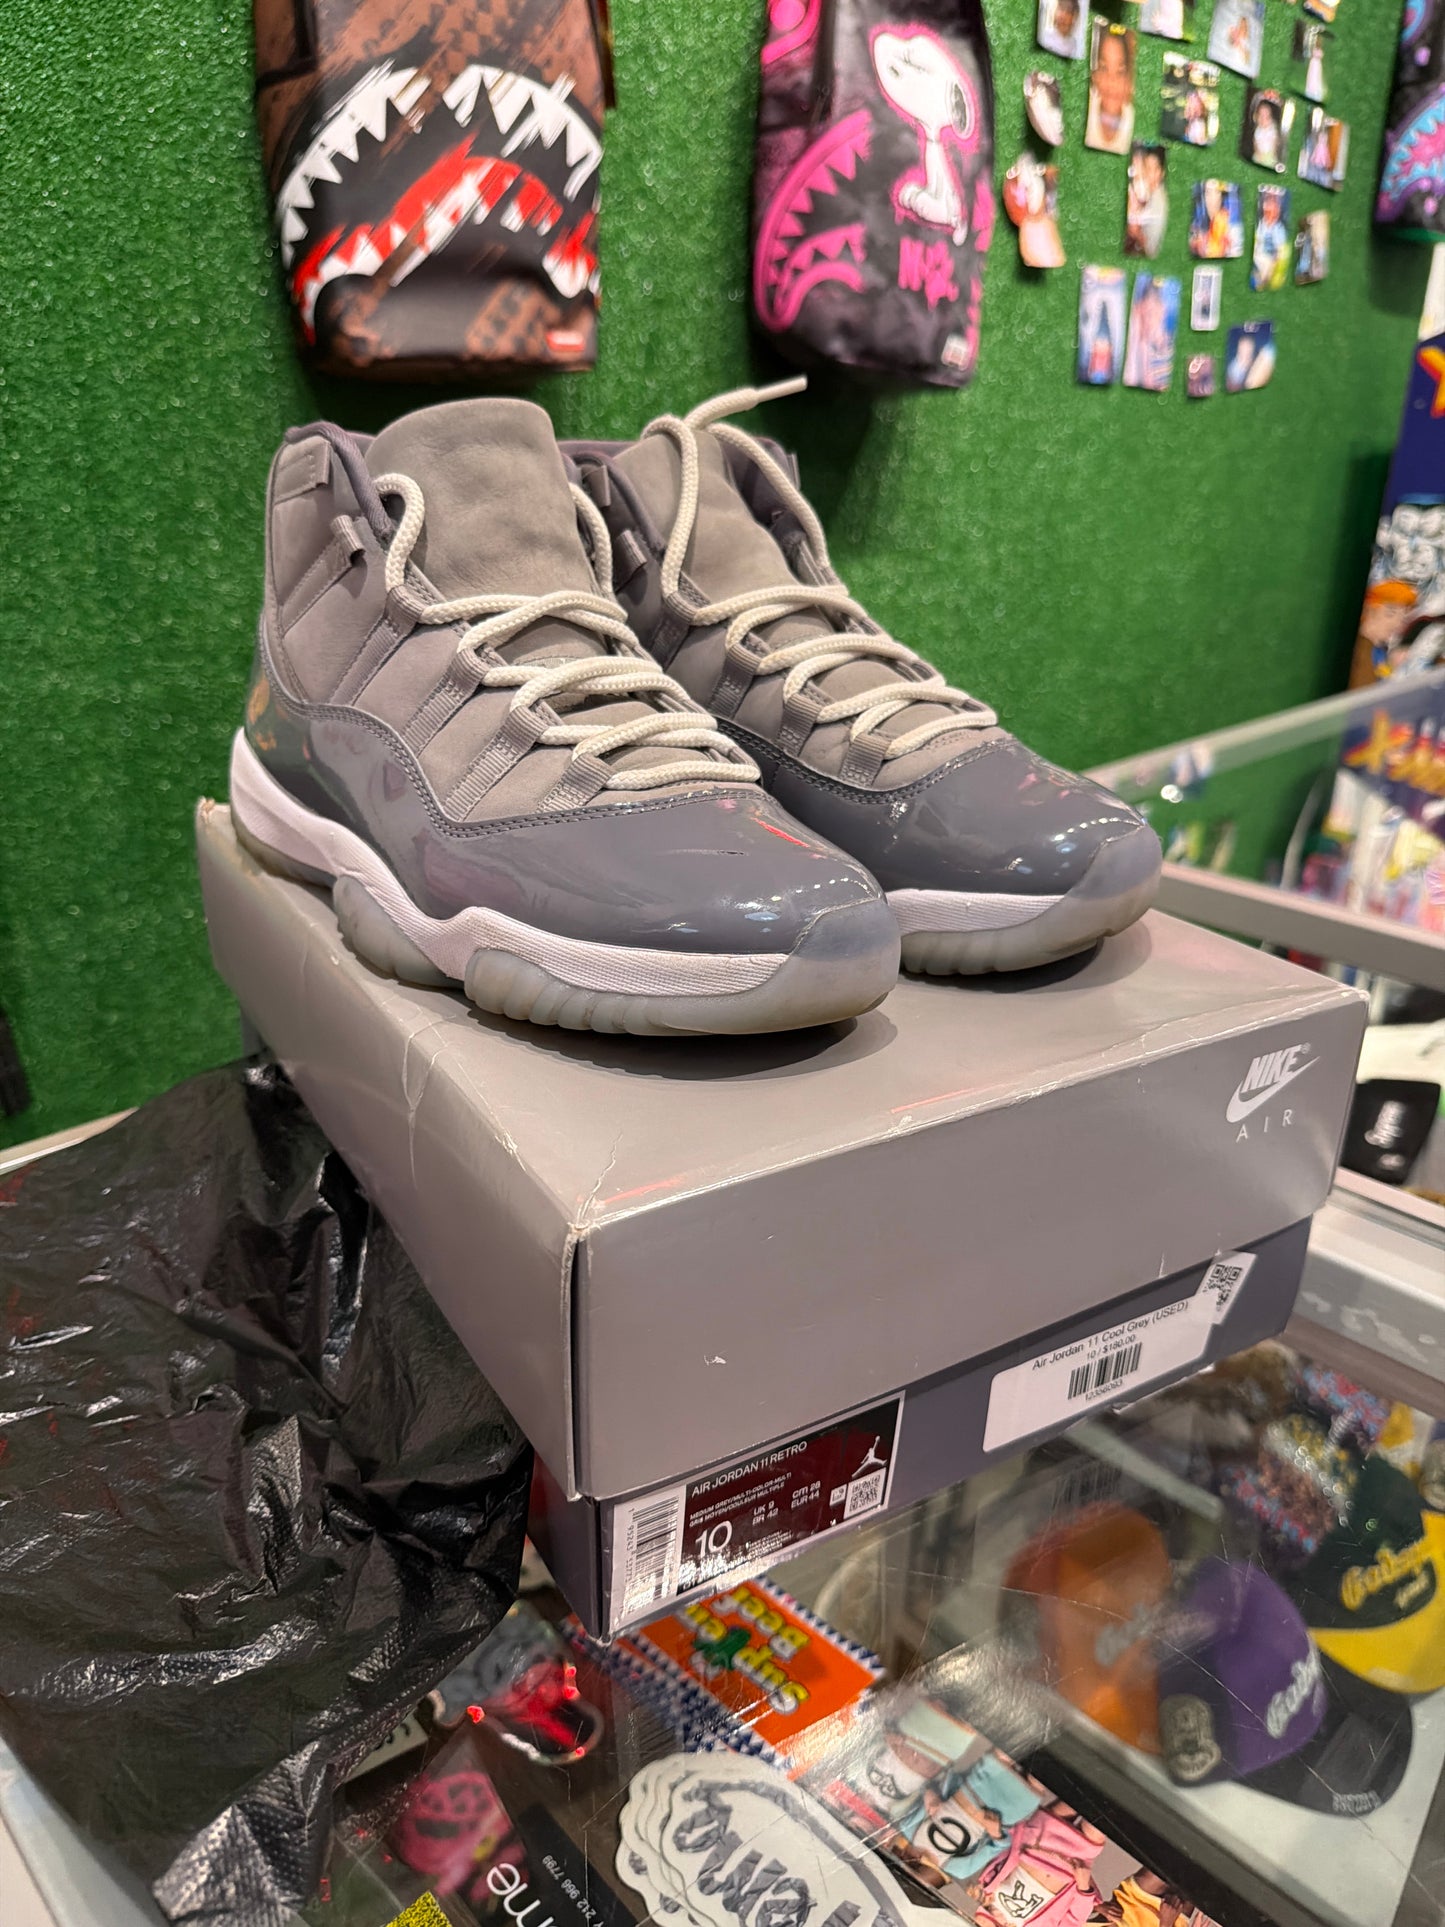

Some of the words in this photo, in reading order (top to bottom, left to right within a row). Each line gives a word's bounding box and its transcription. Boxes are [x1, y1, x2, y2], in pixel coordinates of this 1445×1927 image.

[1240, 1044, 1302, 1093] NIKE
[1236, 1108, 1293, 1143] AIR
[1032, 1358, 1046, 1371] Air
[1049, 1343, 1084, 1364] Jordan
[1087, 1336, 1098, 1348] 11
[1101, 1328, 1125, 1342] Cool
[1127, 1317, 1150, 1333] Grey
[1151, 1300, 1189, 1324] (USED)
[1086, 1350, 1097, 1360] 10
[691, 1480, 712, 1499] AIR
[711, 1463, 760, 1488] JORDAN
[760, 1457, 771, 1470] 11
[769, 1441, 808, 1463] RETRO
[689, 1504, 715, 1521] MEDIUM
[753, 1504, 766, 1516] UK
[791, 1495, 809, 1510] EUR
[809, 1491, 820, 1504] 44
[752, 1514, 765, 1526] BR
[695, 1520, 732, 1558] 10
[711, 1586, 810, 1660] Beef
[542, 1854, 565, 1881] 7799
[561, 1878, 581, 1900] 966
[576, 1898, 597, 1919] 212
